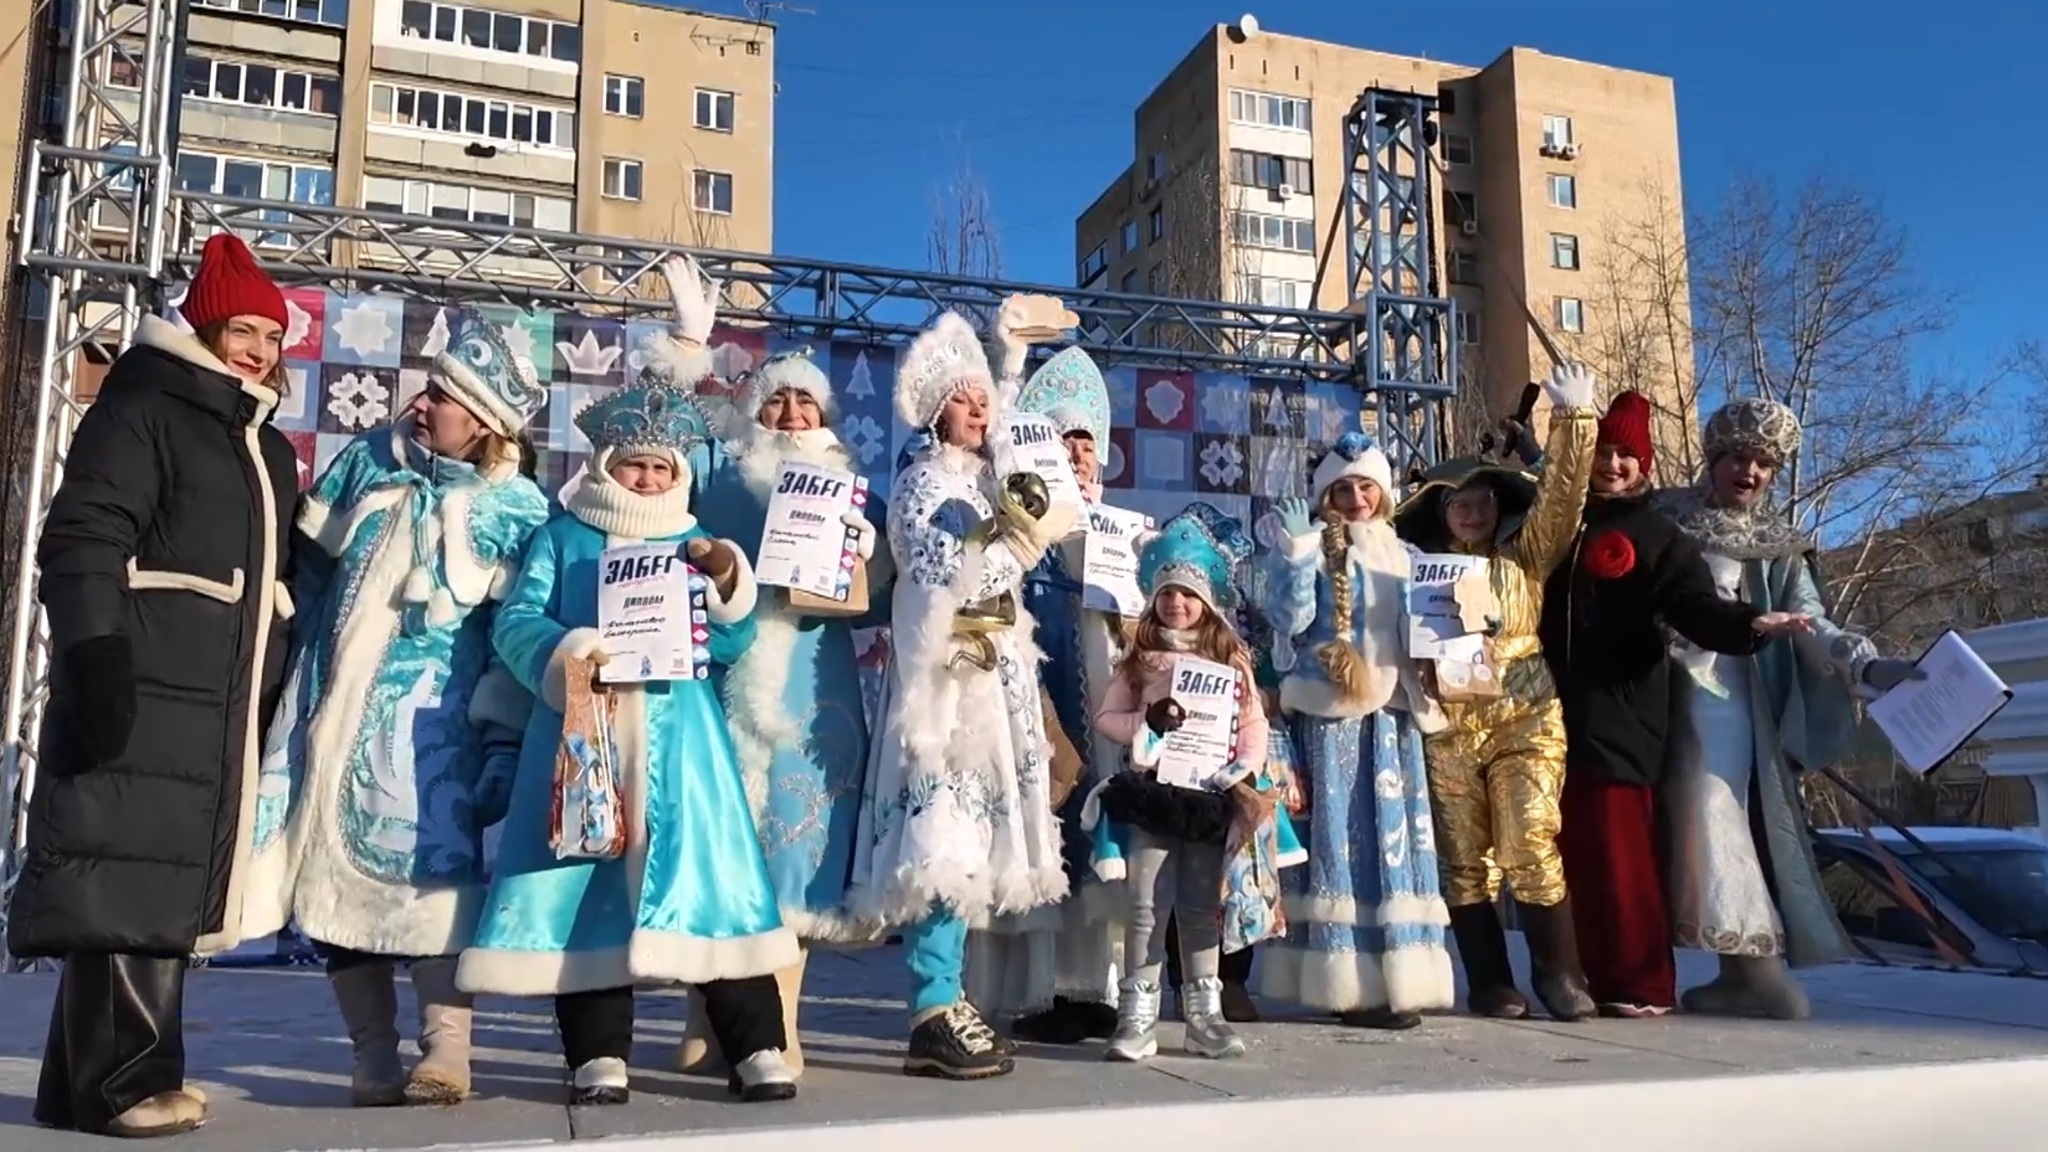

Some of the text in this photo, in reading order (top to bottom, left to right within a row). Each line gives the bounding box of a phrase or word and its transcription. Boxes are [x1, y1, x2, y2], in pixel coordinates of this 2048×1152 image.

[777, 471, 846, 498] ЗАБЕГ
[788, 509, 826, 523] ДИПЛОМ
[604, 555, 677, 585] ЗАБЕГ
[622, 595, 665, 610] ДИПЛОМ
[1176, 670, 1231, 696] ЗАБЕГ
